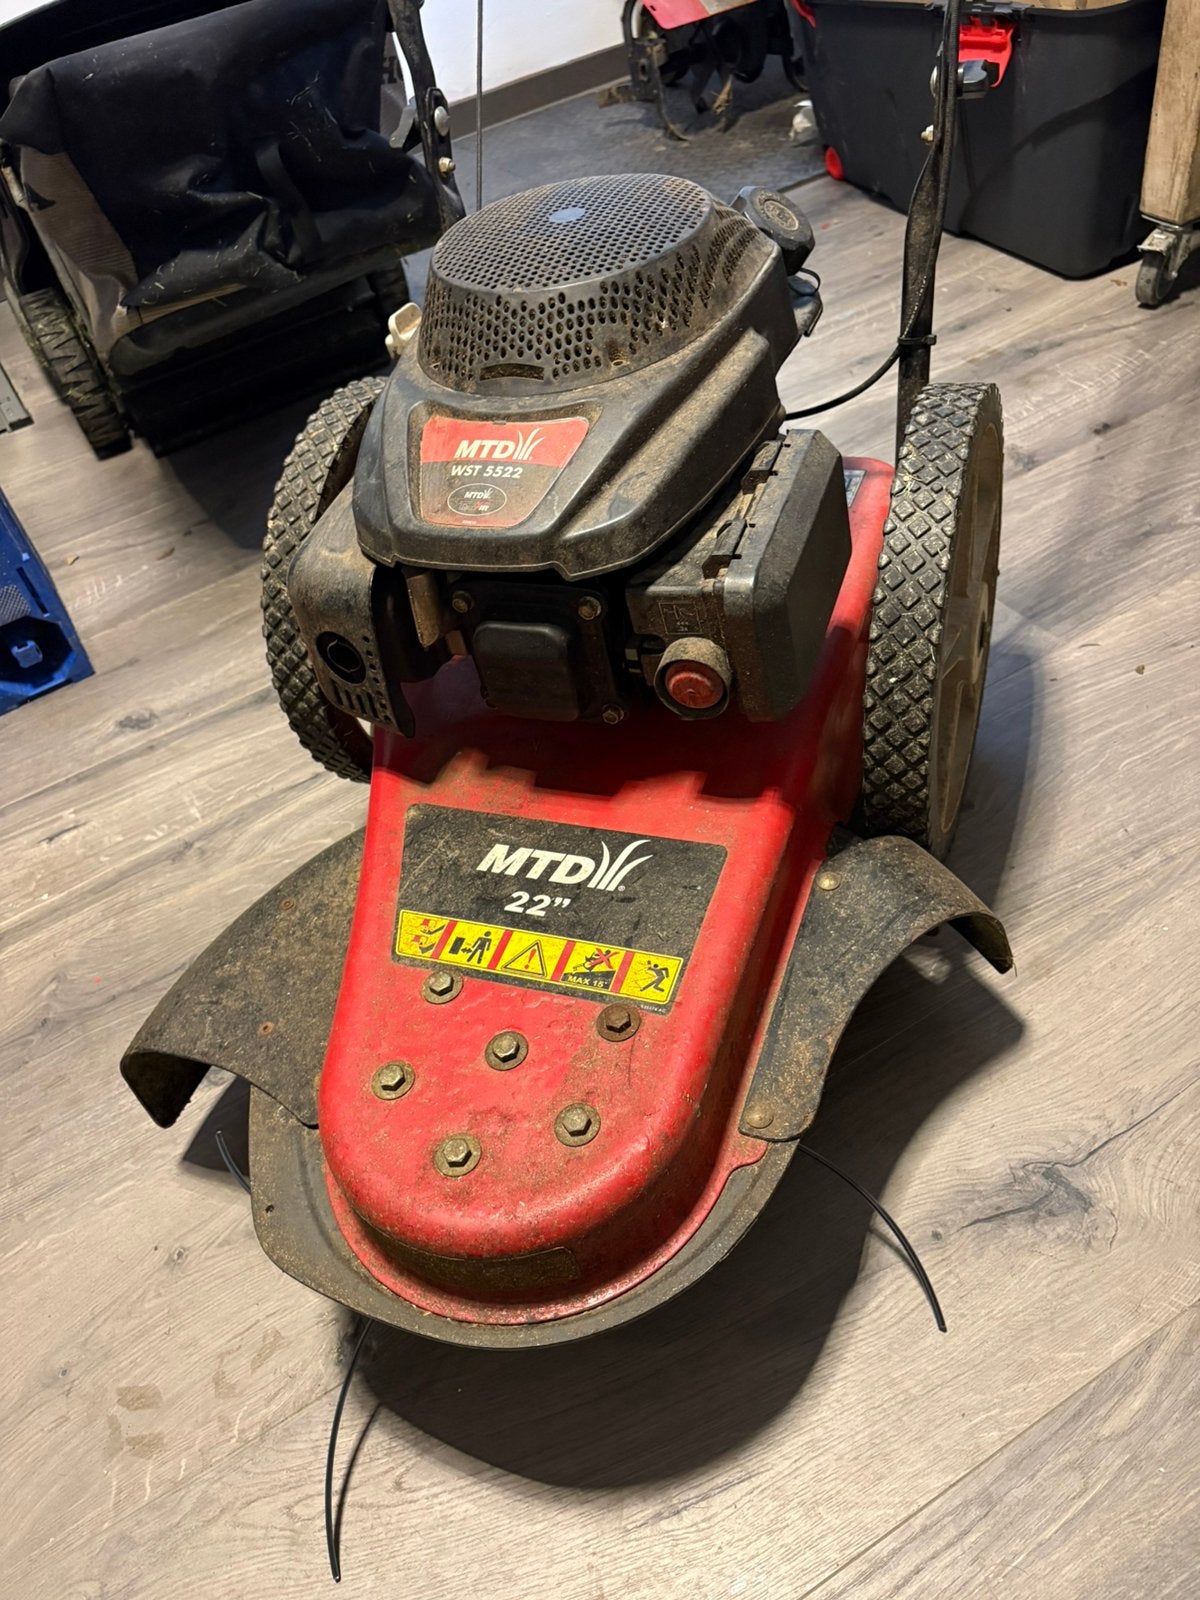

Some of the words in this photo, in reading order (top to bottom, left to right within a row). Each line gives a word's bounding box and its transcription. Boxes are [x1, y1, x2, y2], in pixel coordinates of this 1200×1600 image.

[453, 439, 516, 459] MTD
[451, 465, 482, 476] WST
[483, 465, 523, 478] 5522
[464, 491, 485, 499] MTD
[476, 843, 596, 884] MTD
[568, 974, 590, 985] MAX
